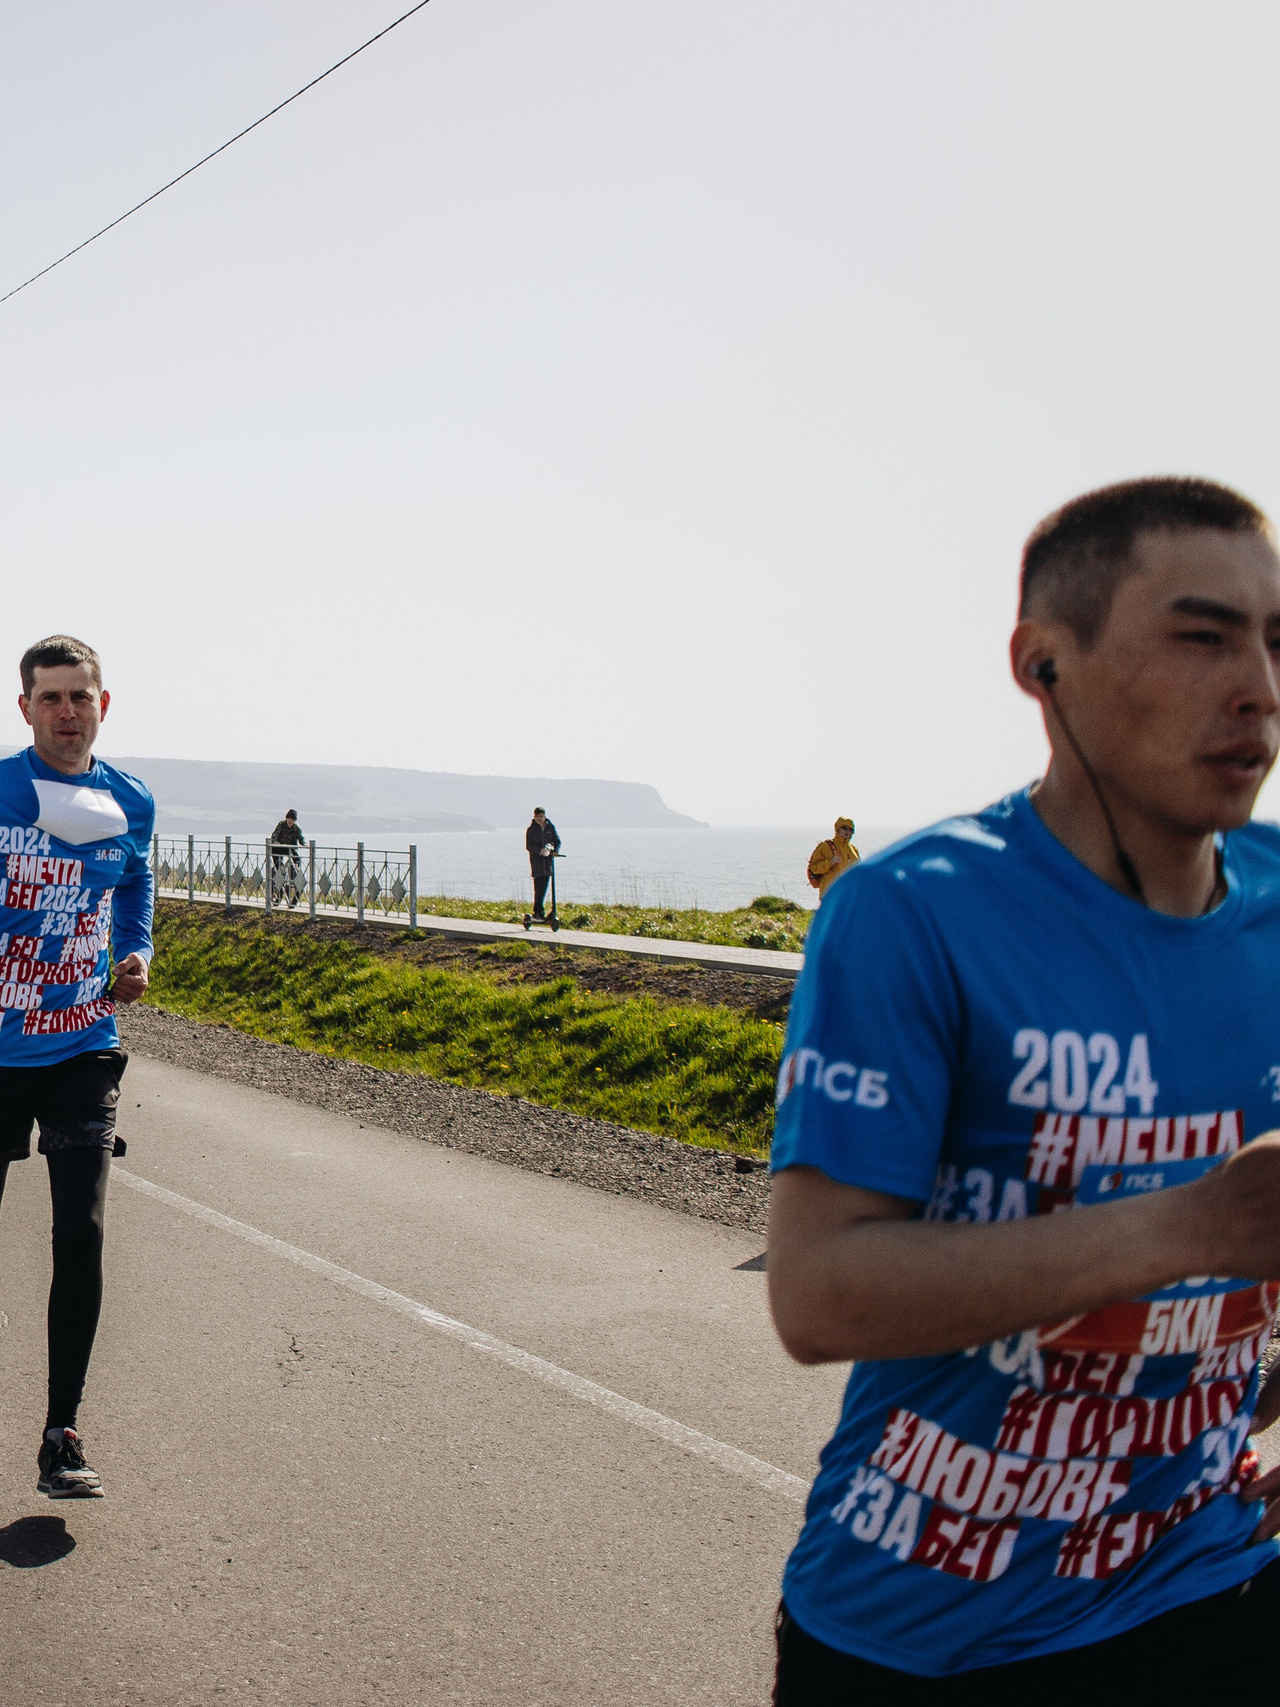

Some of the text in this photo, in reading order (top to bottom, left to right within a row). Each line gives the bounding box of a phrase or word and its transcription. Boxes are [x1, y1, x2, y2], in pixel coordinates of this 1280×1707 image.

[7, 854, 83, 887] #МЕЧТА
[796, 1048, 889, 1109] ПСБ
[1008, 1029, 1158, 1116] 2024
[870, 1407, 1132, 1522] #ЛЮБОВЬ
[830, 1466, 1021, 1583] #ЗАБЕГ
